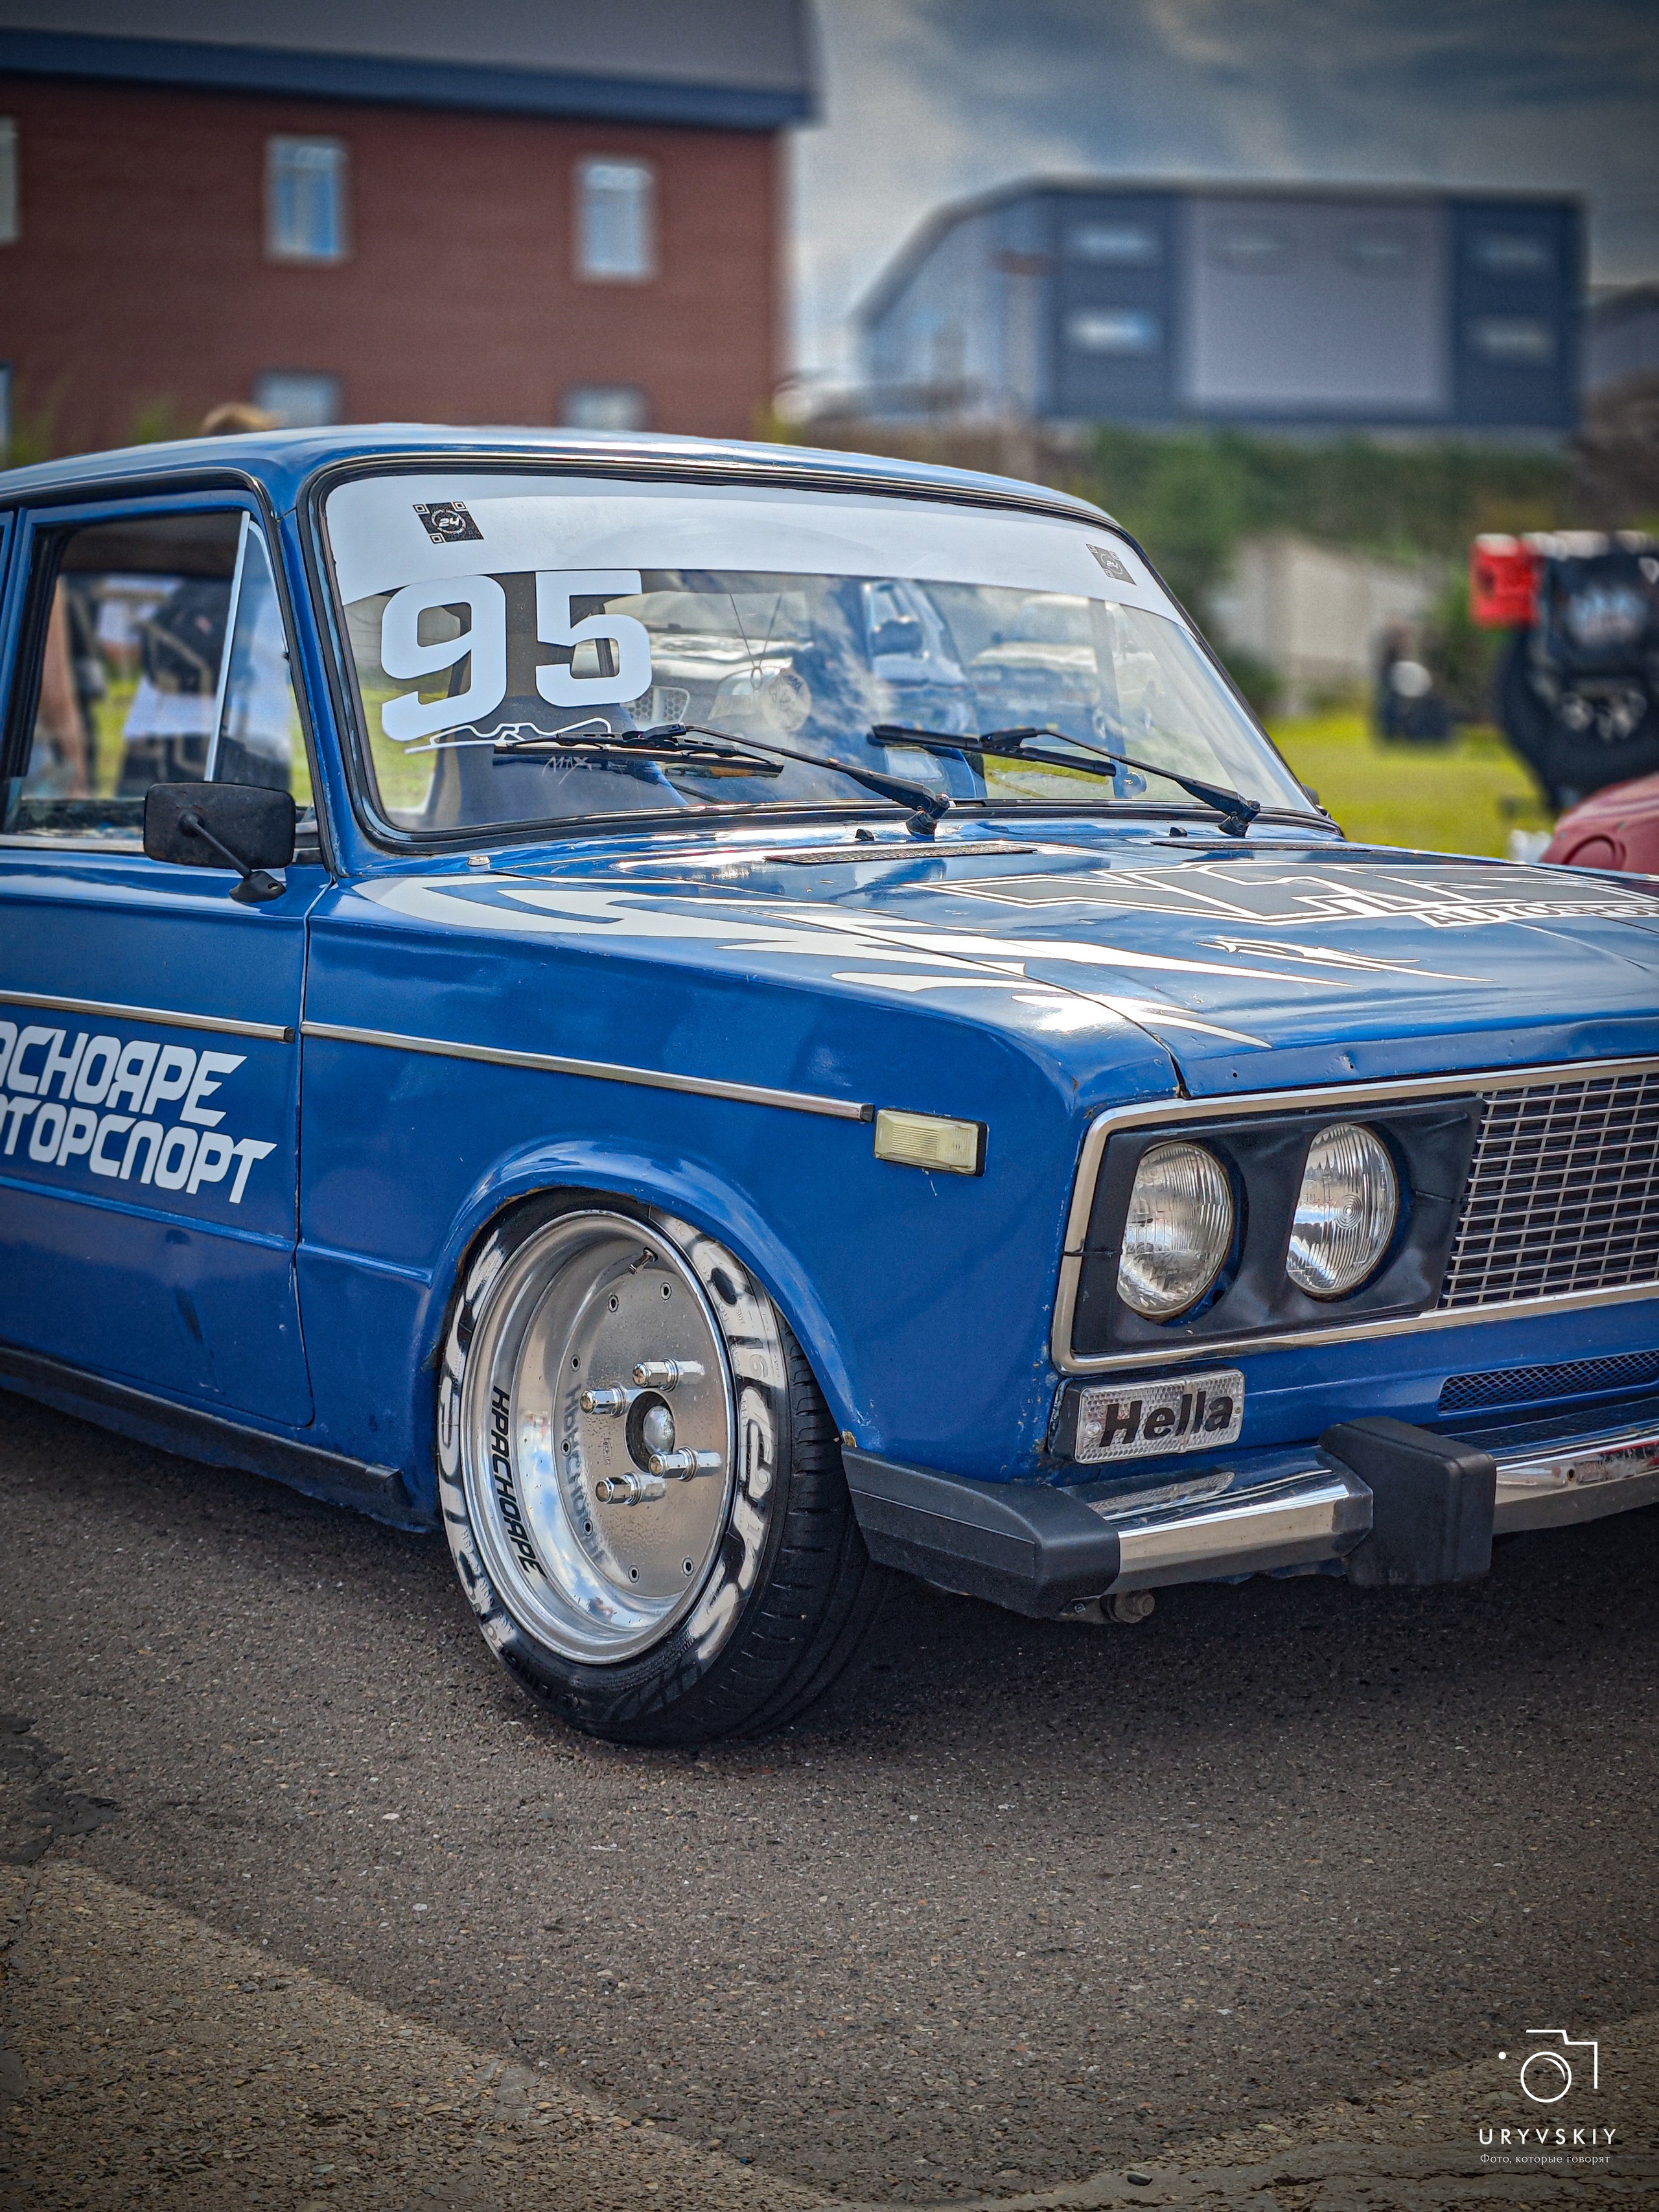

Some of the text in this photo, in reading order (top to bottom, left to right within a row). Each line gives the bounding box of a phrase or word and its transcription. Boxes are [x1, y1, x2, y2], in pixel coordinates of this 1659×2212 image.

[438, 517, 460, 528] 24
[381, 570, 652, 741] 95
[0, 1093, 278, 1204] ТОРСПОРТ
[1099, 1390, 1234, 1447] Hella
[491, 1385, 548, 1579] КРАСНОЯРЕ
